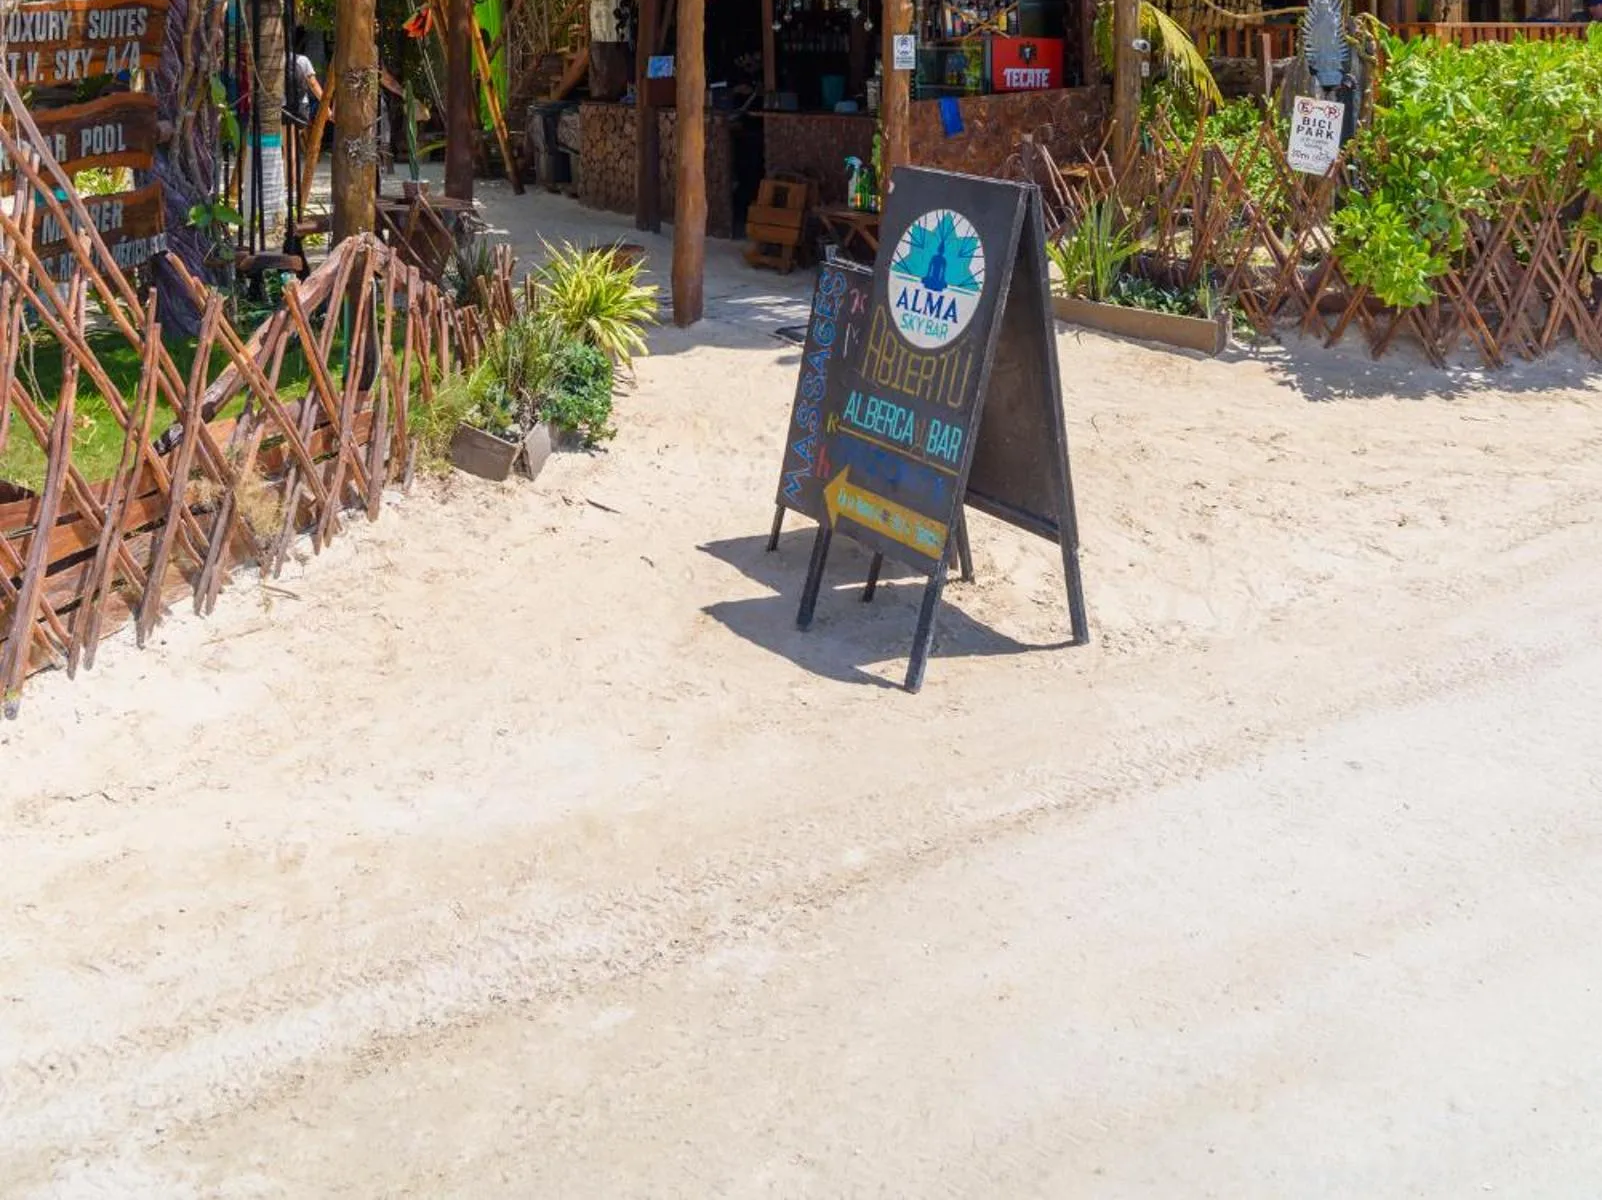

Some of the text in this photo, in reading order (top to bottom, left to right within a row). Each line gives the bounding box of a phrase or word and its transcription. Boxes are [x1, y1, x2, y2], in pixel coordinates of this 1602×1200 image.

[5, 7, 148, 43] UXURY SUITES
[54, 49, 93, 81] SKY
[1003, 67, 1050, 89] TECATE
[1296, 125, 1334, 140] PARK
[1302, 116, 1333, 130] BICI
[81, 123, 126, 158] POOL
[896, 287, 958, 324] ALMA
[900, 312, 949, 340] SKY BAR
[784, 270, 847, 501] MASSAGES
[842, 389, 915, 446] ALBERCA
[926, 417, 963, 464] BAR
